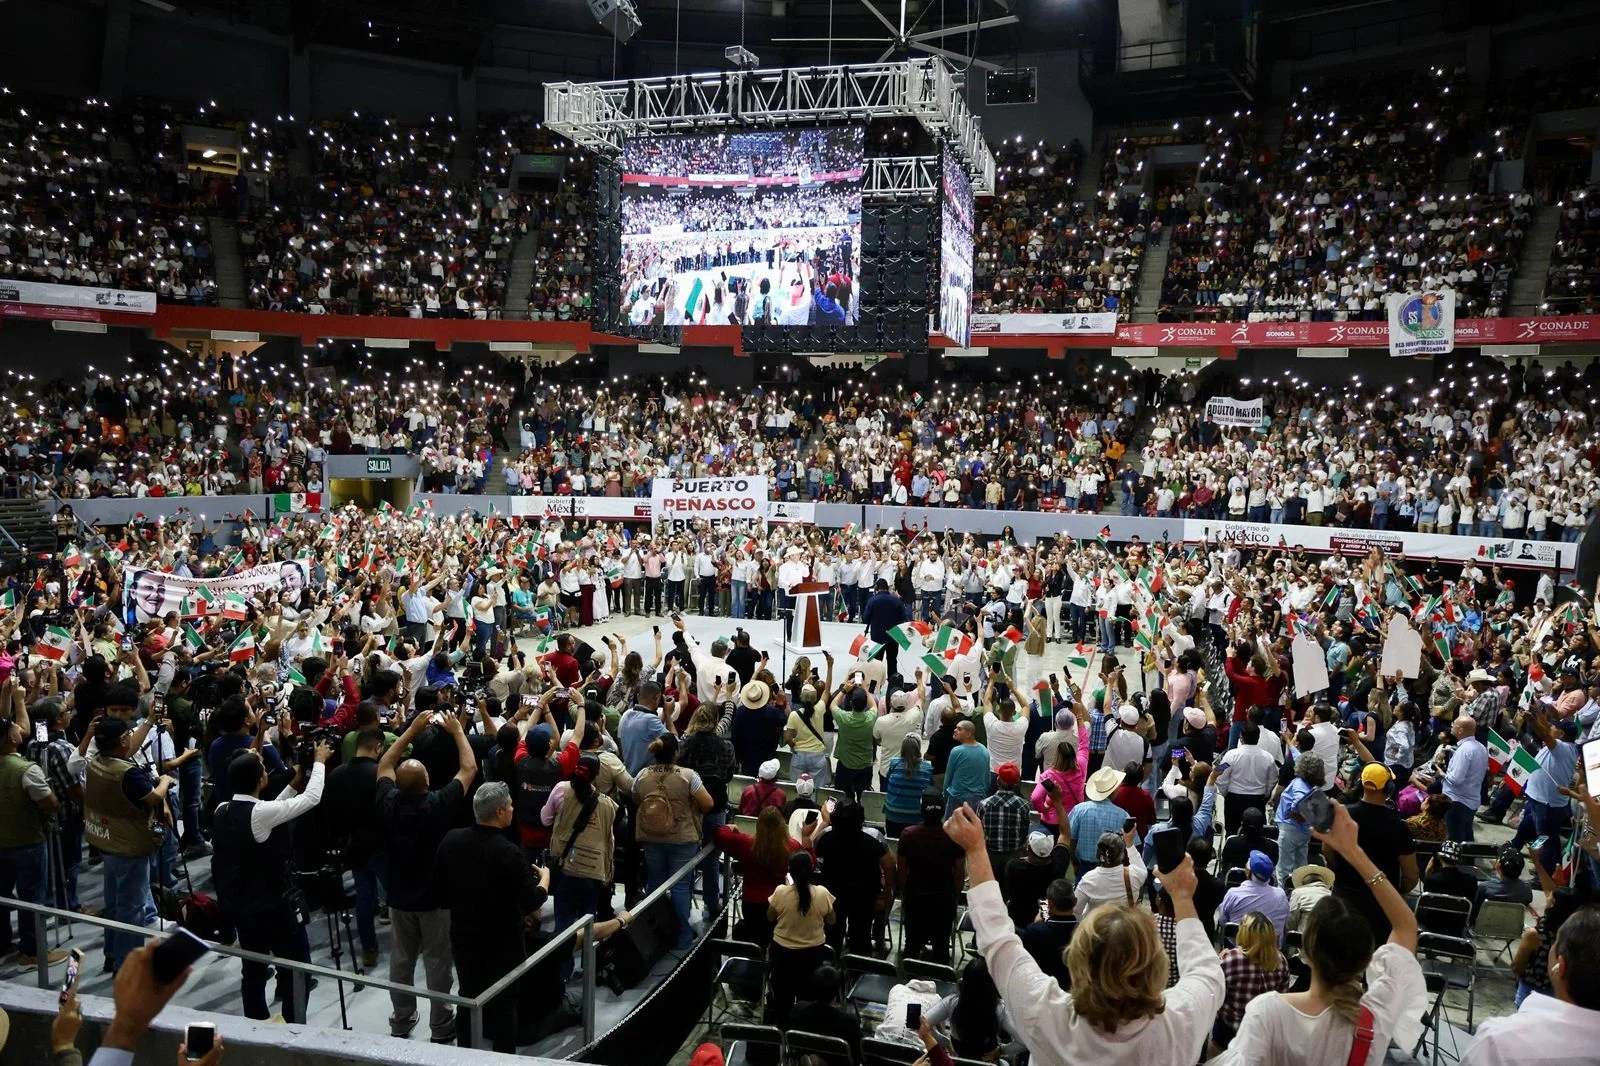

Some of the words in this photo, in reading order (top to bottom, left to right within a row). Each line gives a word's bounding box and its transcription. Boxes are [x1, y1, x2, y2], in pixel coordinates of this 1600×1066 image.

[1347, 327, 1390, 335] CONADE
[1539, 321, 1590, 331] CONADE
[1177, 328, 1216, 336] CONADE
[1207, 404, 1234, 416] ADULTO
[1235, 407, 1261, 418] MAYOR
[368, 460, 391, 471] SALIDA
[672, 479, 749, 493] PUERTO
[547, 503, 585, 514] Méxco
[663, 495, 756, 511] PEÑASCO
[1226, 530, 1269, 543] México
